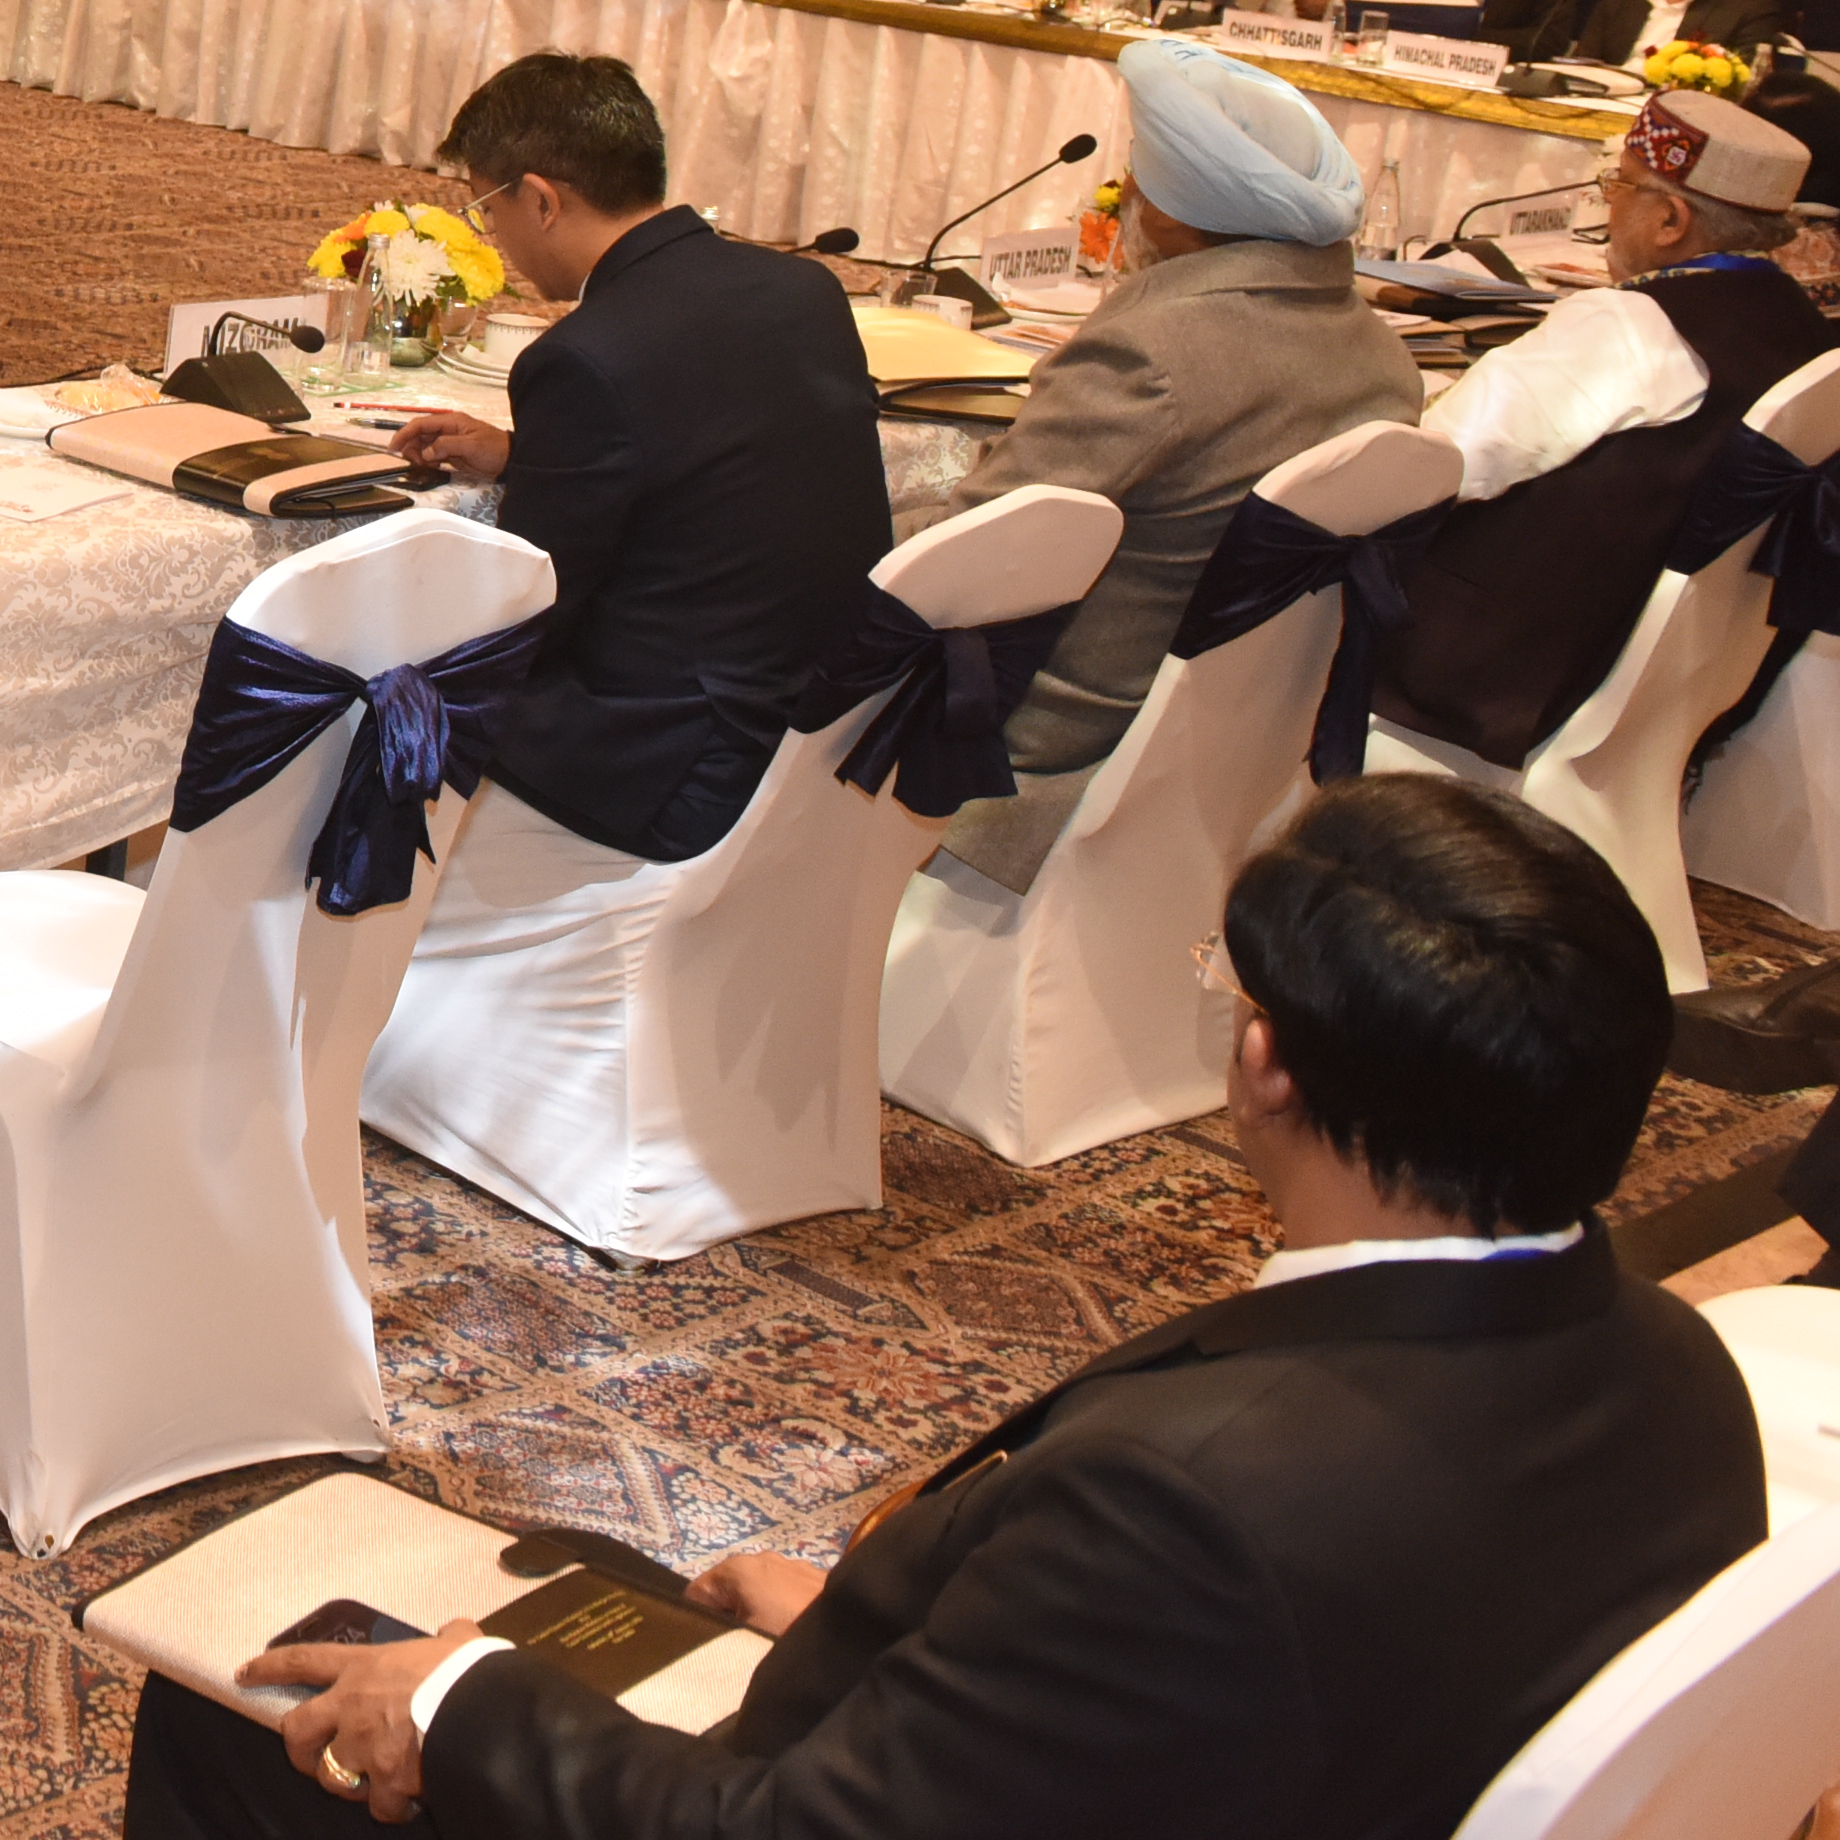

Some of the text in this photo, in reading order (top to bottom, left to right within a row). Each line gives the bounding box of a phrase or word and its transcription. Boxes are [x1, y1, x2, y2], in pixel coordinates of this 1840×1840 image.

[1394, 45, 1497, 76] HIMACHAL PRADESH
[1022, 244, 1072, 277] PRADESH
